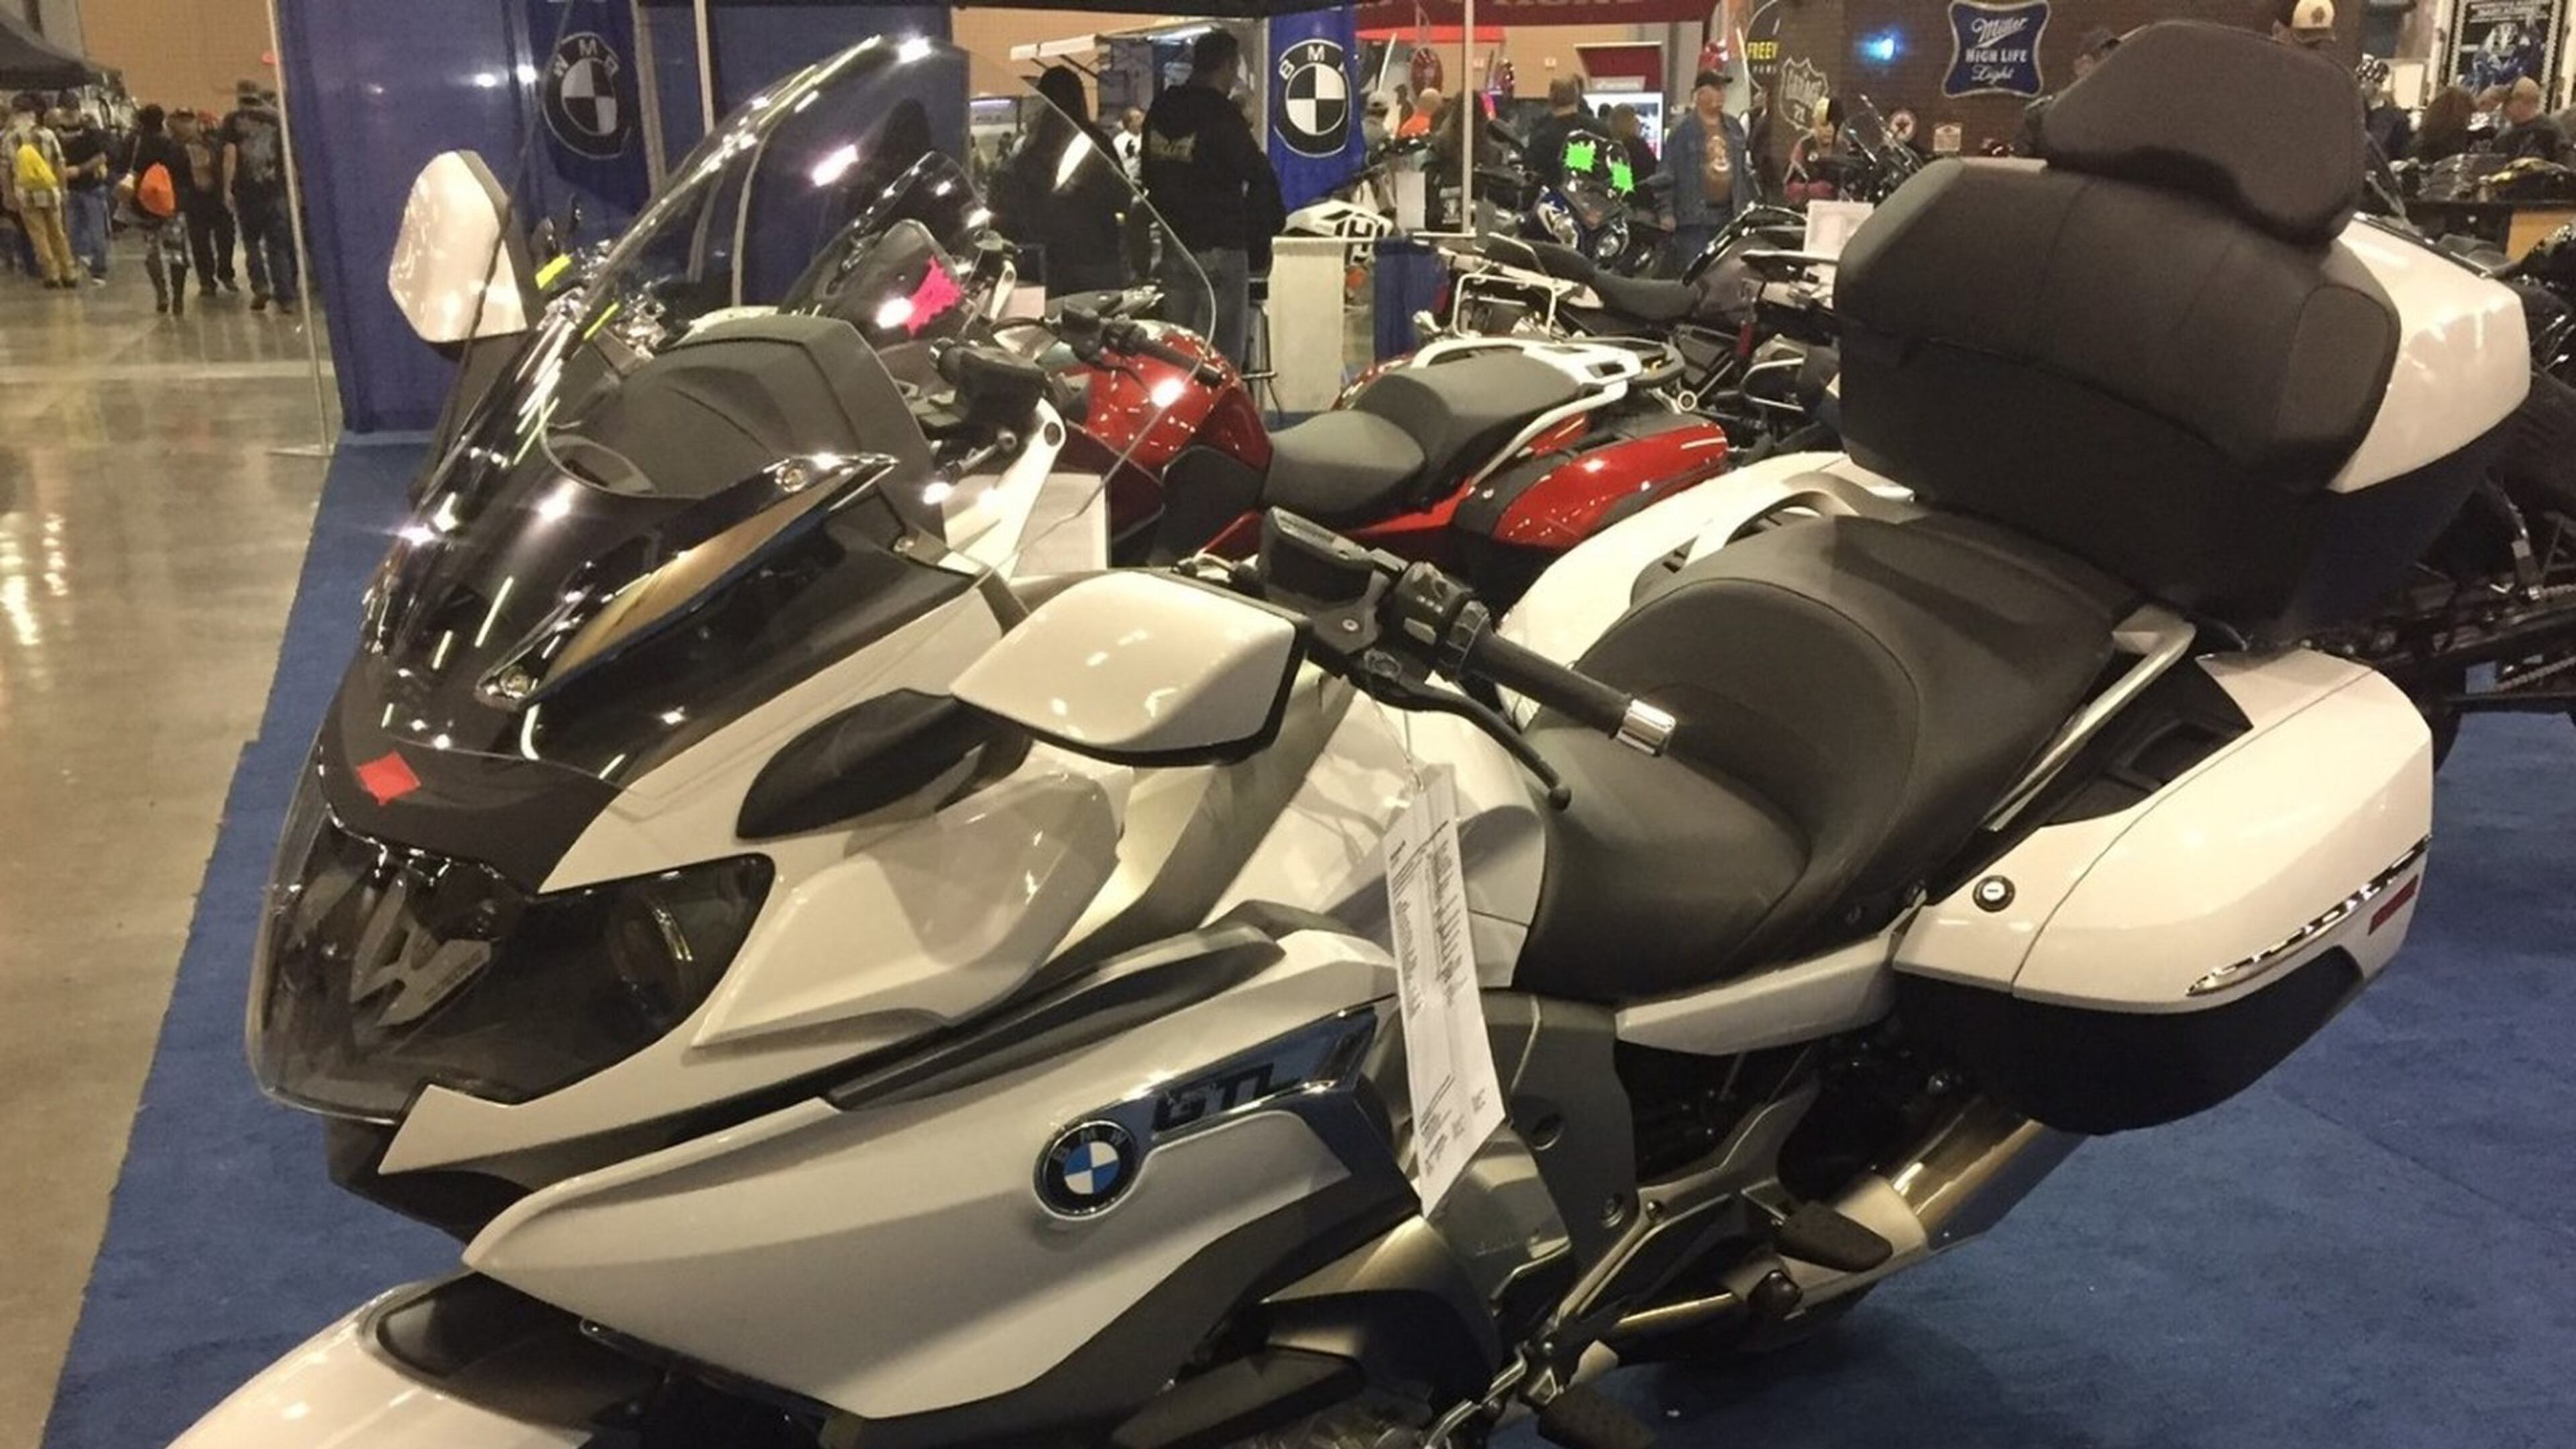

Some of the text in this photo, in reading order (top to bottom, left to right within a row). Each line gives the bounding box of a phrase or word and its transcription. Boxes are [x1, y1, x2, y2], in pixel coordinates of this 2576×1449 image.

[1966, 48, 2027, 63] HIGH LIFE
[1971, 64, 2015, 85] Light
[1051, 1128, 1130, 1162] BMW
